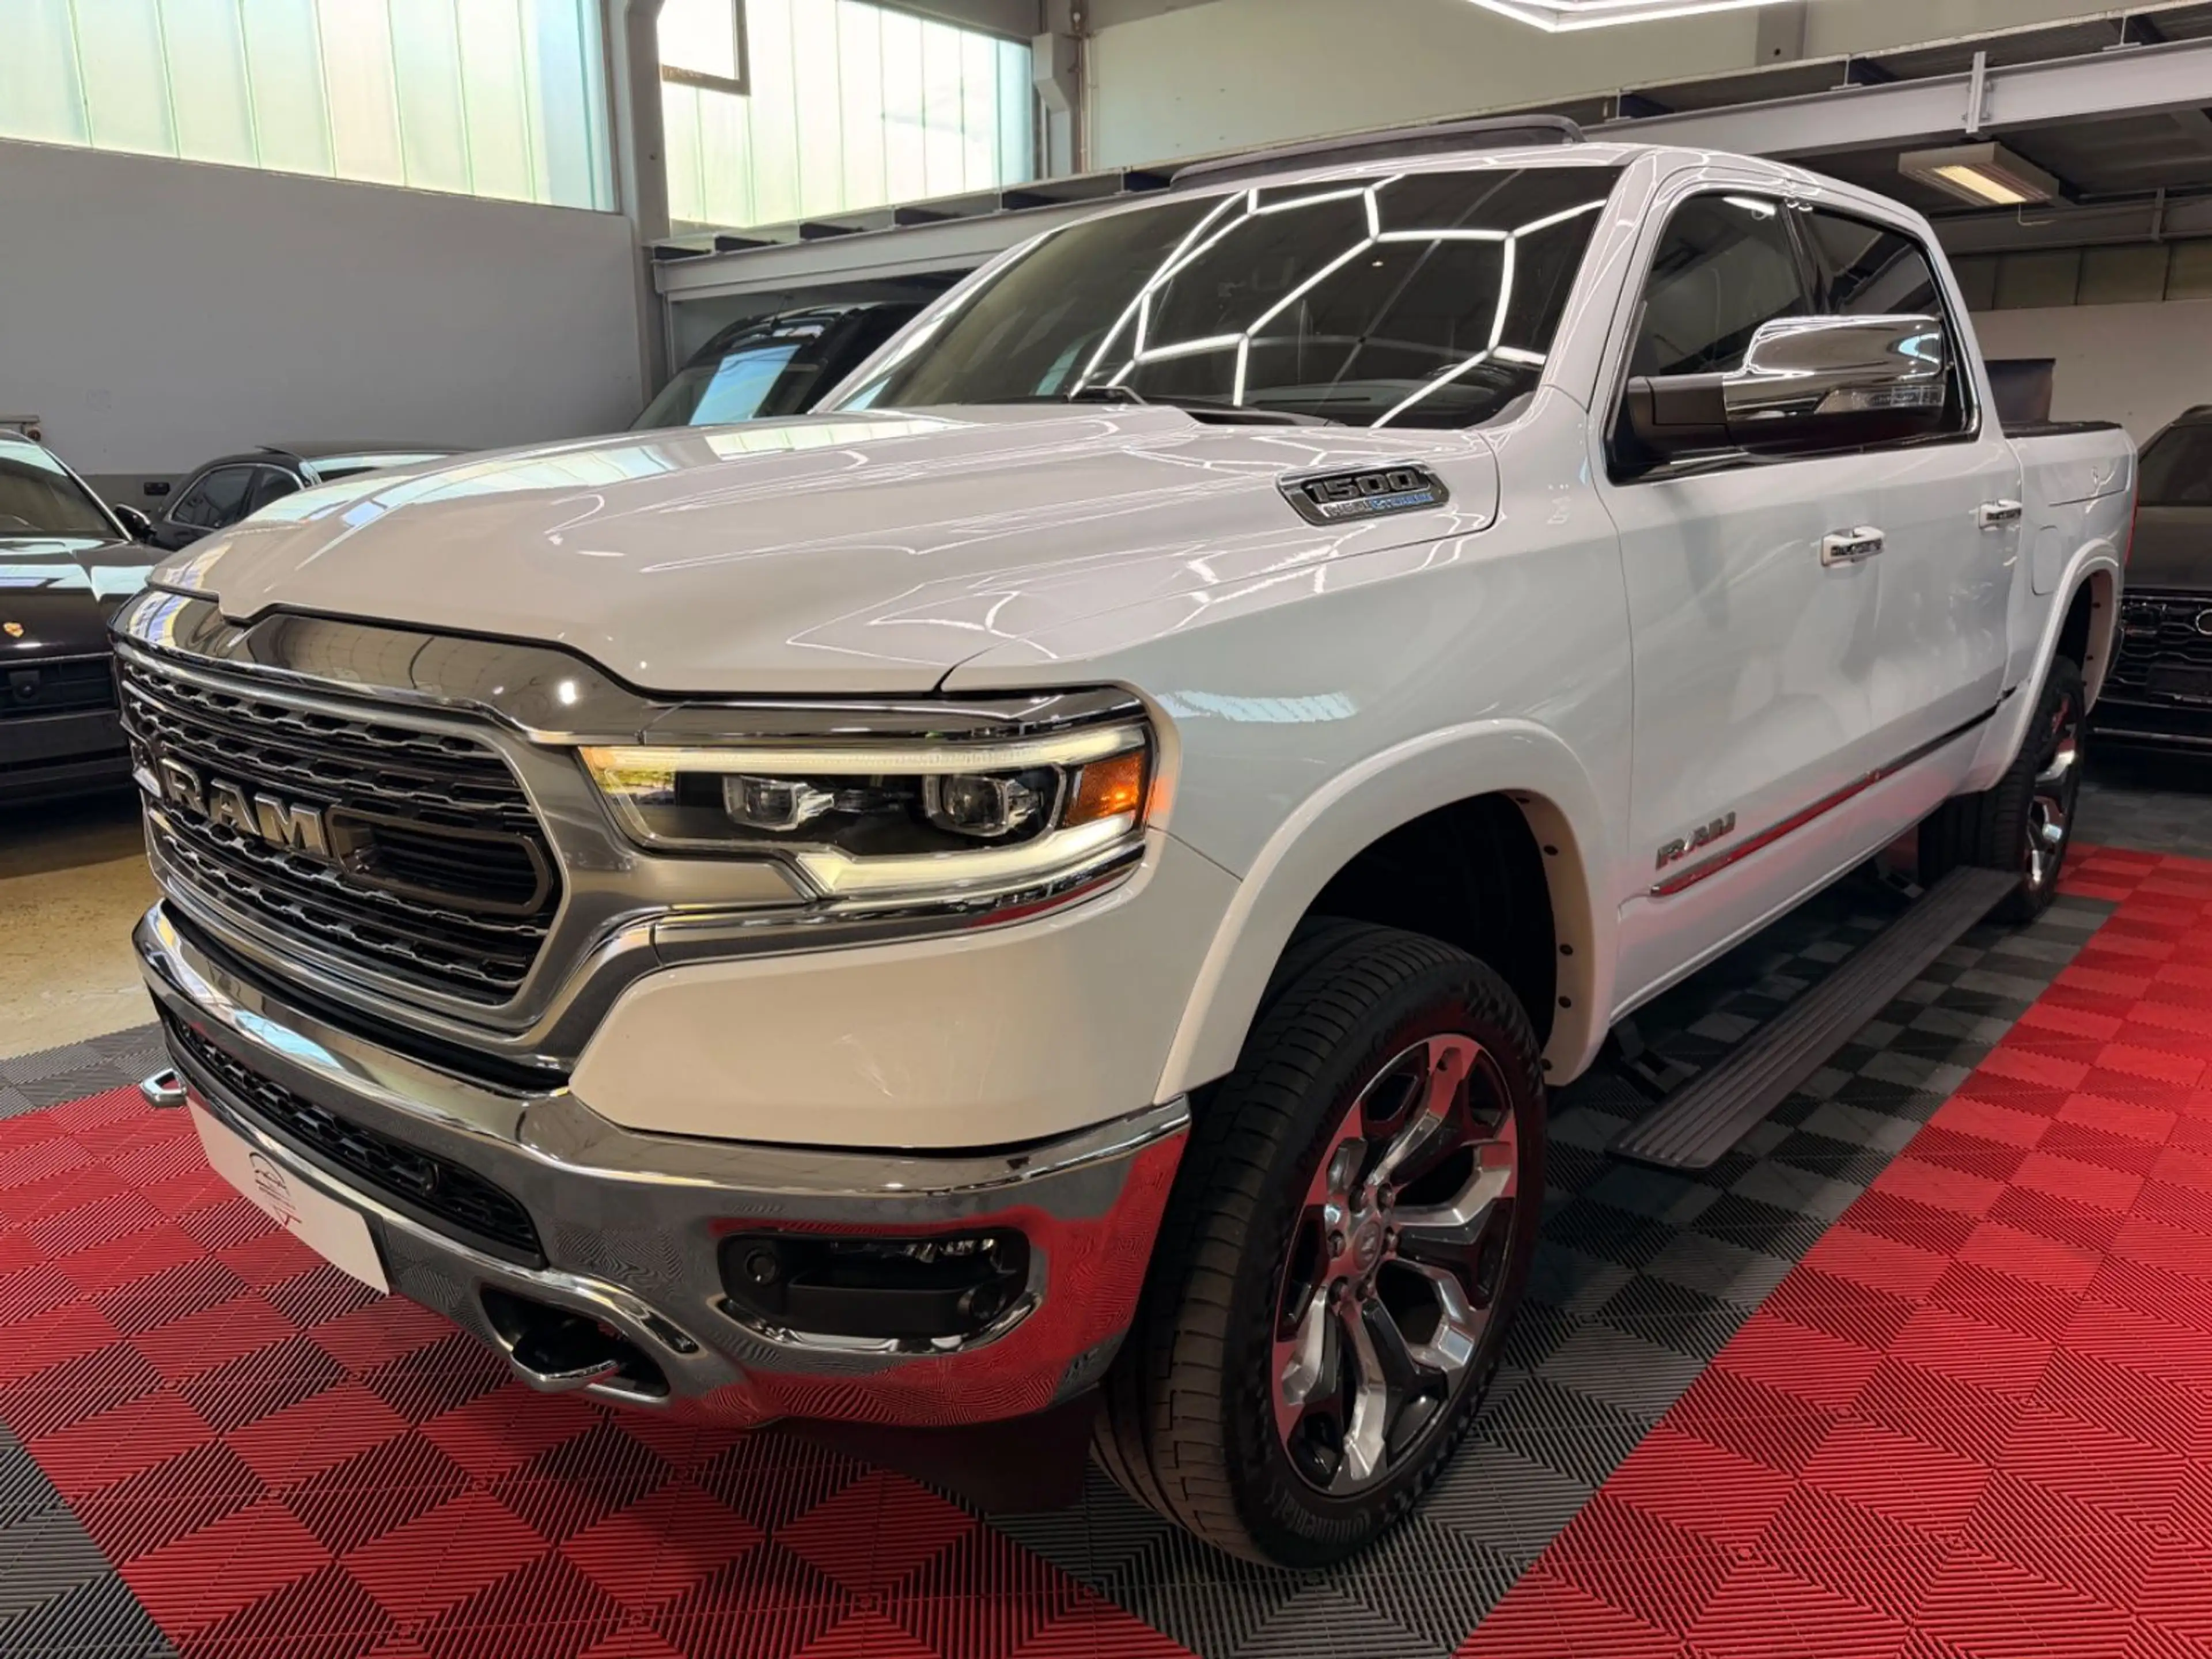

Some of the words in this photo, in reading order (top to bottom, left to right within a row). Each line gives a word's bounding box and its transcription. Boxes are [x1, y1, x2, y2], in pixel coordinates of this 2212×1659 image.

[1306, 469, 1420, 503] 1500
[158, 756, 330, 858] RAM
[1655, 810, 1736, 872] RAM
